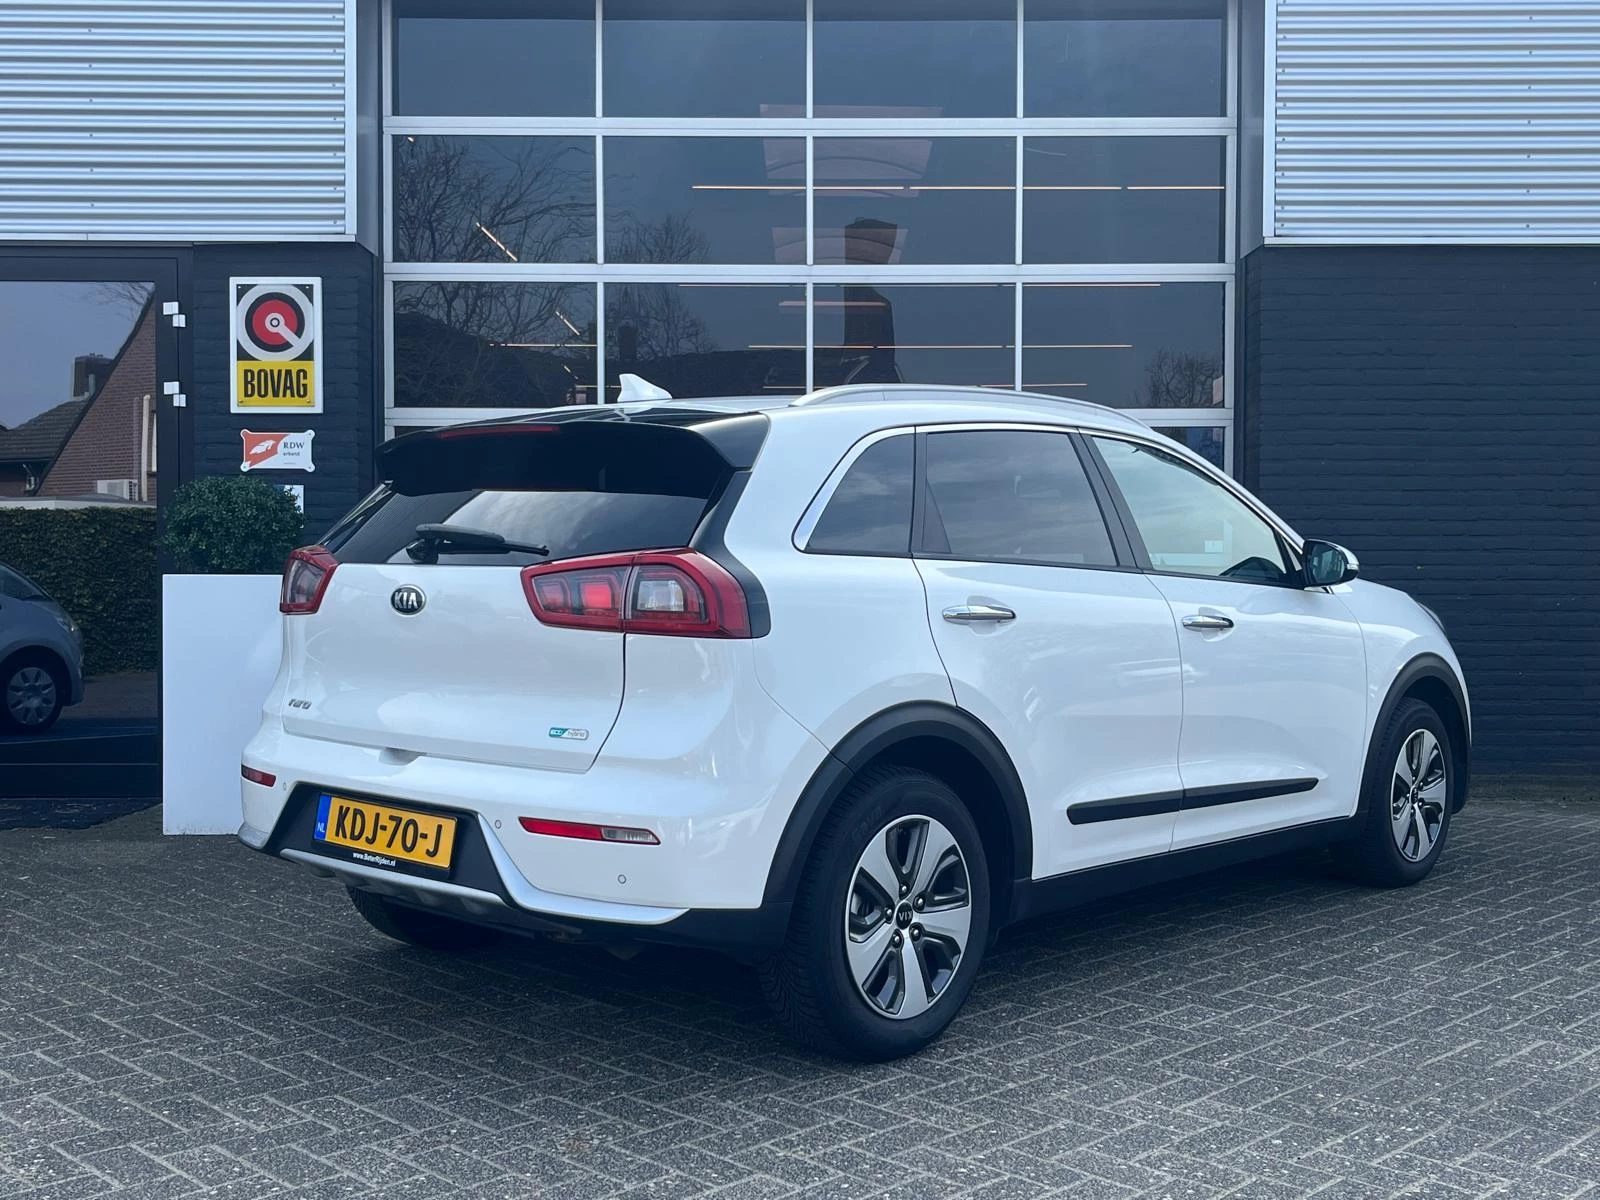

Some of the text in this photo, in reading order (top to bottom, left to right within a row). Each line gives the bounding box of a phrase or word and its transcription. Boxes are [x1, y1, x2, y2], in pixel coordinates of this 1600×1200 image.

[243, 368, 308, 398] BOVAG
[283, 441, 305, 449] RDW
[394, 591, 419, 609] KIA
[316, 822, 326, 833] NL
[335, 805, 443, 858] KDJ-70-J
